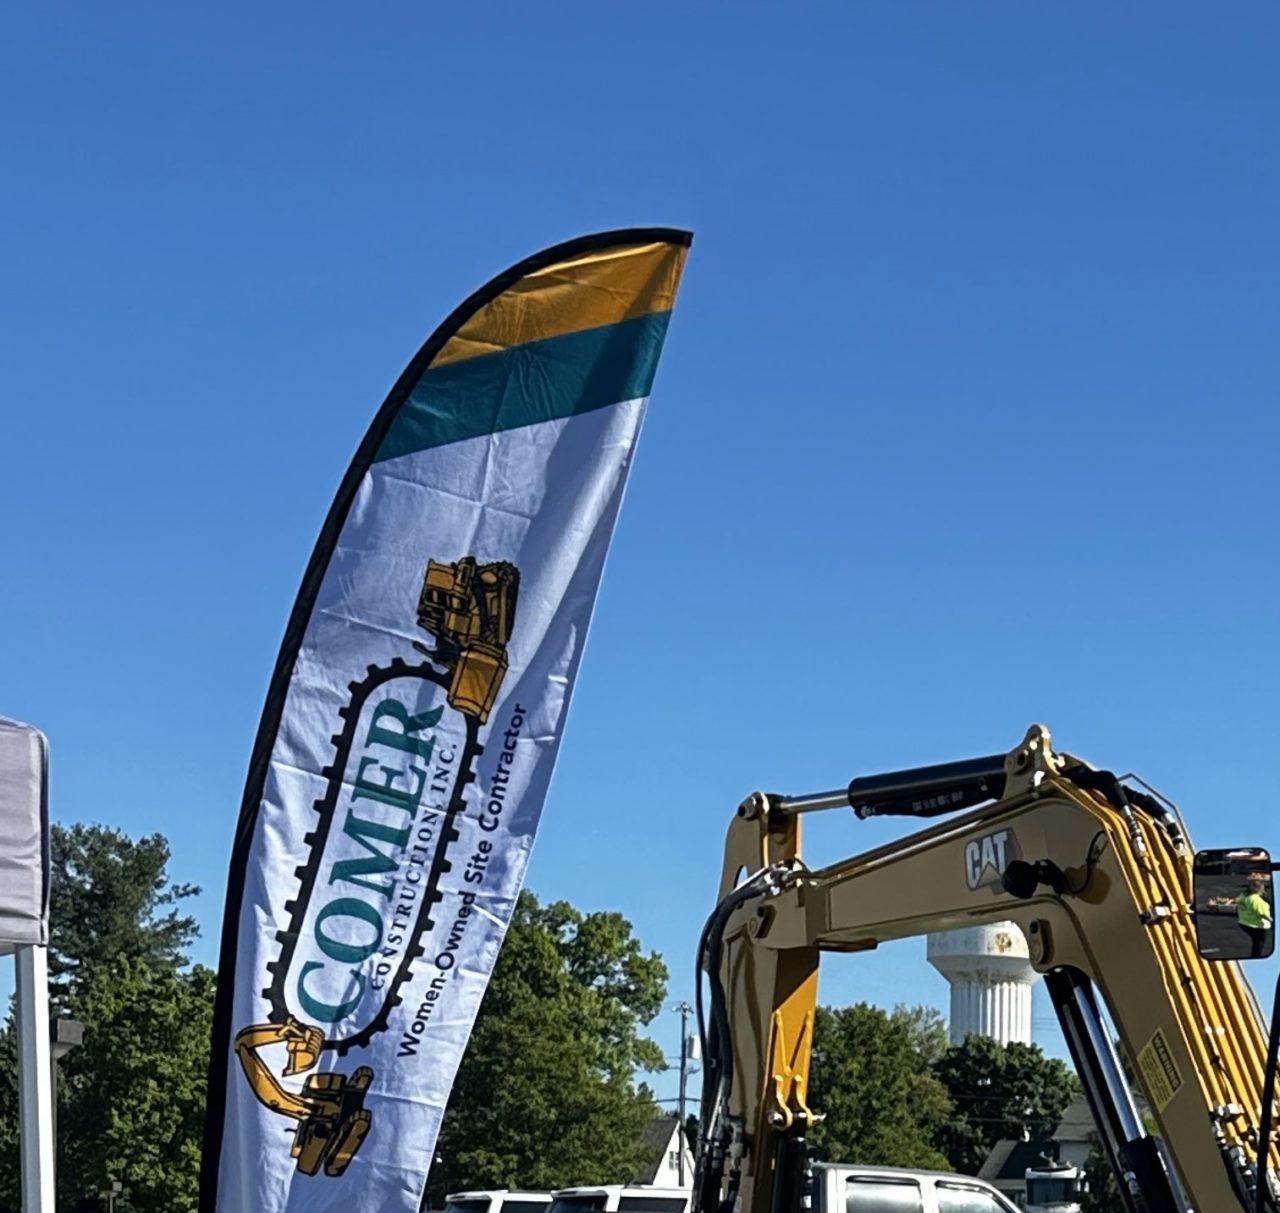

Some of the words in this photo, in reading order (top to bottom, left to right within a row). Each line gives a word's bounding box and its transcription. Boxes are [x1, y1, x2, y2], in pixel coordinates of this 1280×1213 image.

[297, 698, 444, 1024] COMER
[370, 803, 442, 990] CONSTRUCTION,
[430, 743, 457, 794] INC.
[396, 890, 477, 1058] Women-Owned
[464, 839, 493, 884] Site
[479, 703, 527, 832] Contractor
[965, 829, 1009, 889] CAT
[1154, 1036, 1179, 1088] WARNING
